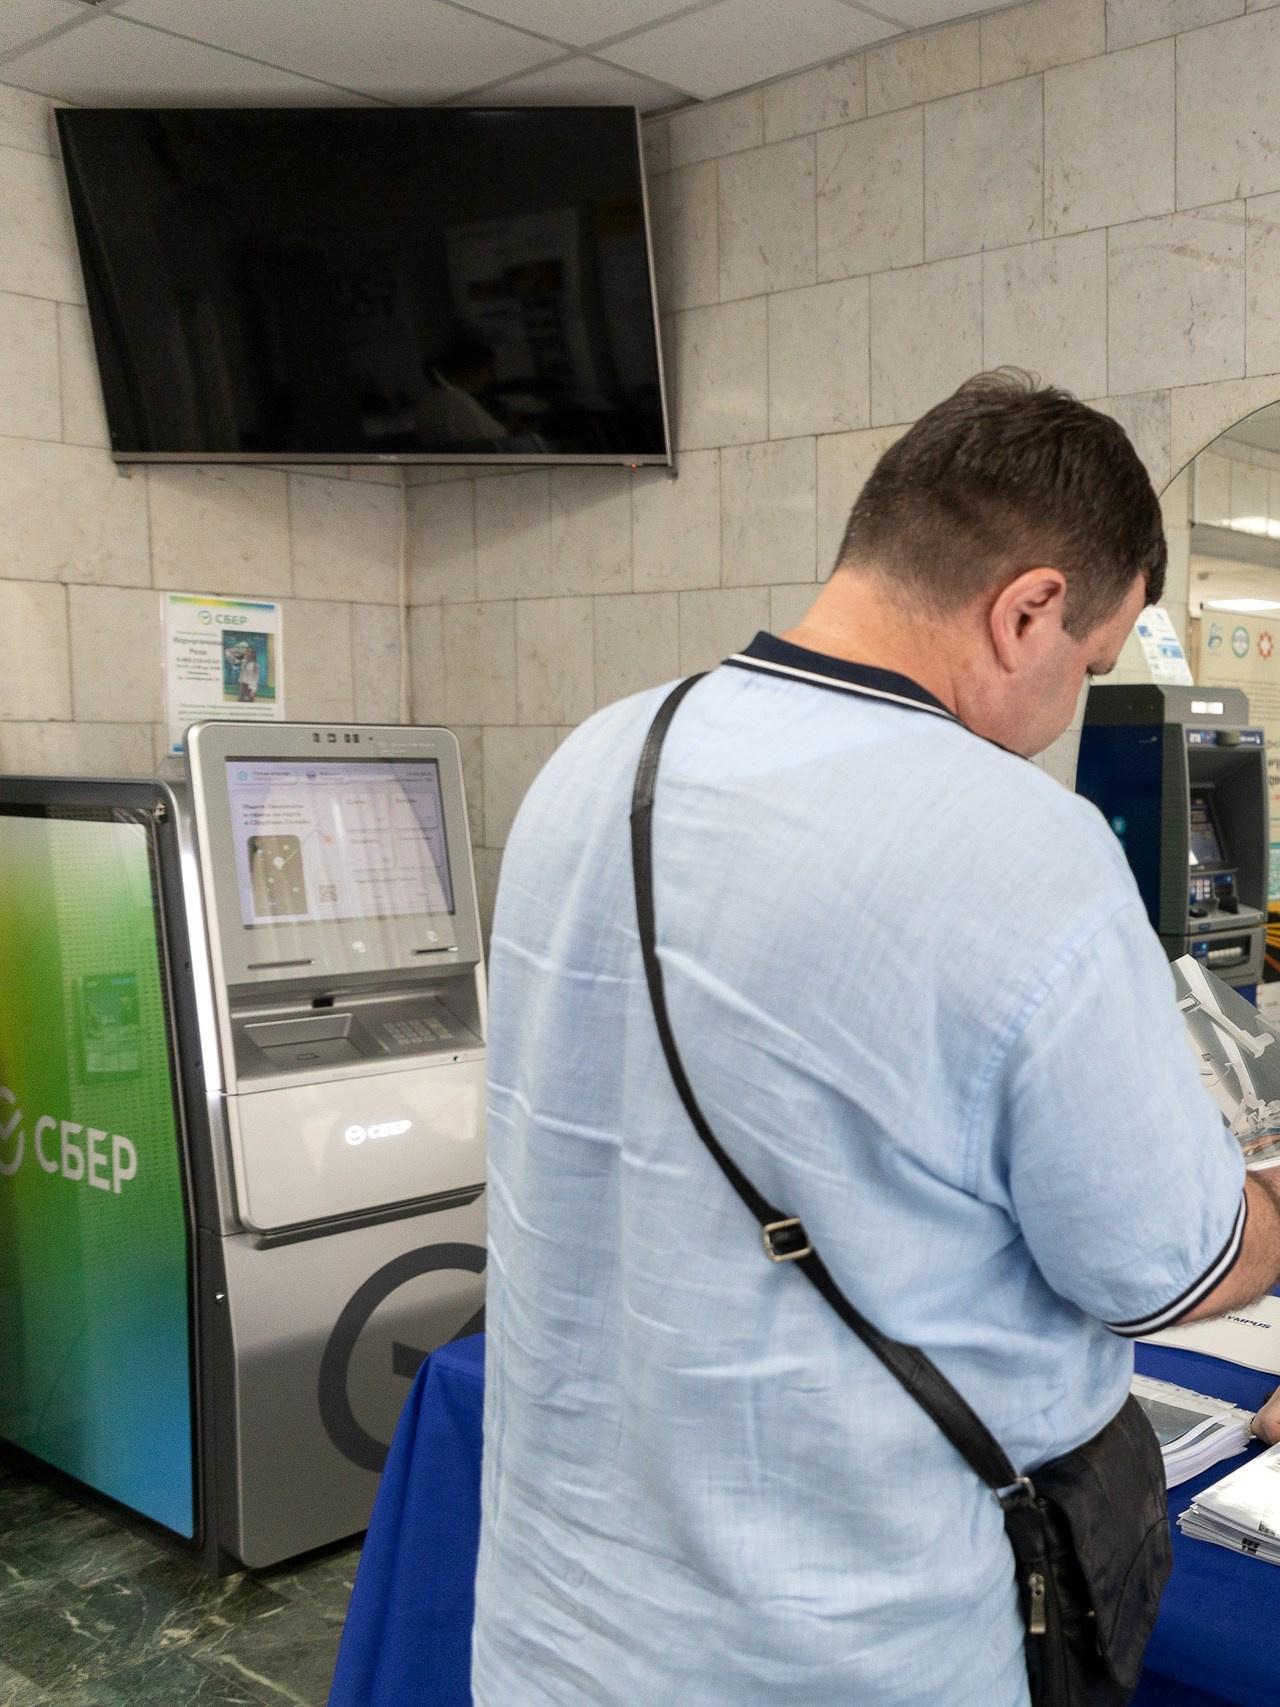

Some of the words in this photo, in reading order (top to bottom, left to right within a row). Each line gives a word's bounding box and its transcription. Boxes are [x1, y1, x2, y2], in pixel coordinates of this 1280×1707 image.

[215, 614, 248, 626] СБЕР
[33, 1115, 138, 1195] СБЕР
[1221, 1314, 1272, 1329] LYMPUS
